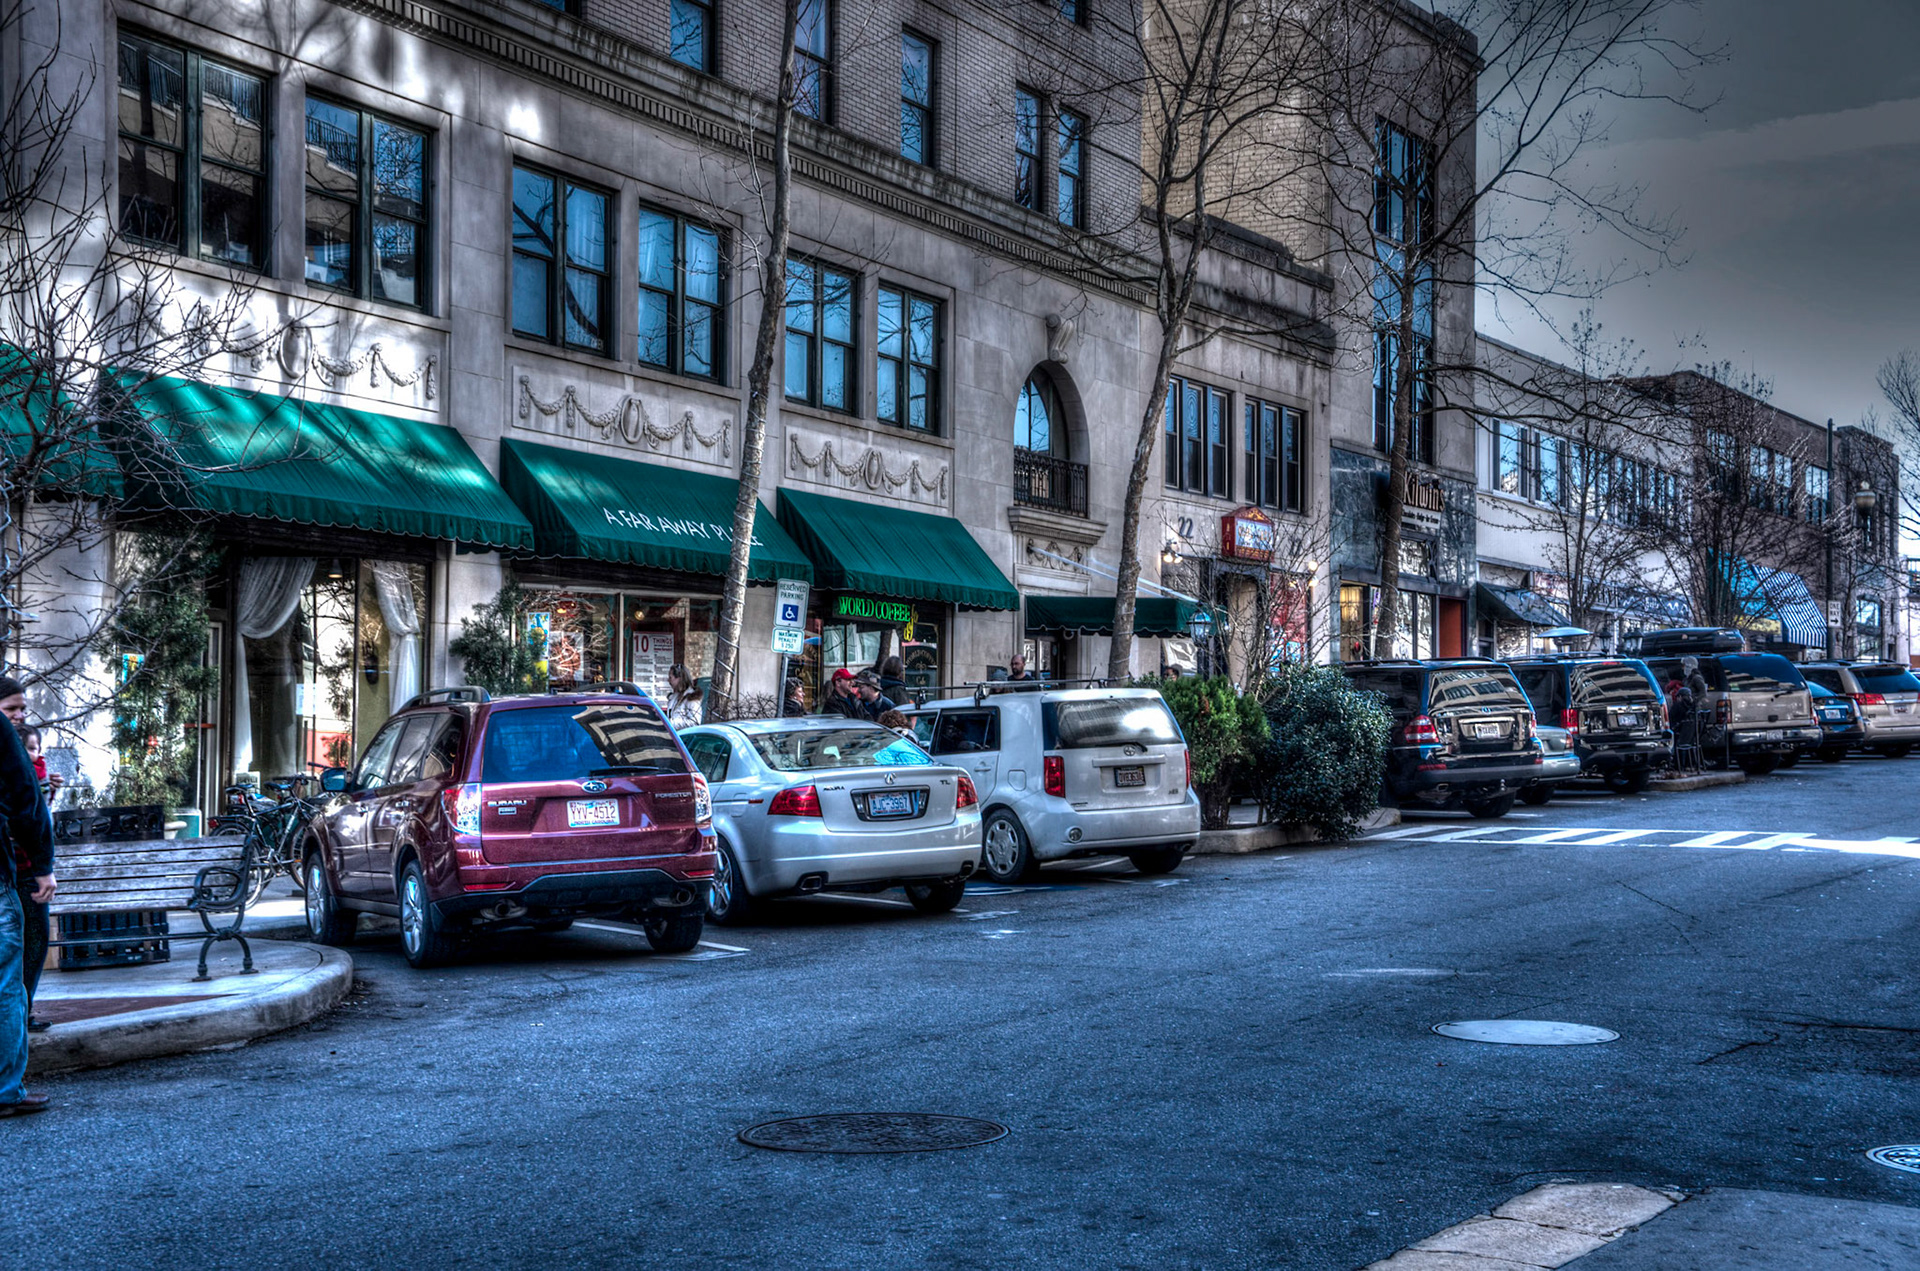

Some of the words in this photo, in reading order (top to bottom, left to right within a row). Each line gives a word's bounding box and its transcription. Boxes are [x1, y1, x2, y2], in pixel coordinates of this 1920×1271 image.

[603, 507, 624, 527] A
[617, 509, 660, 532] FAR
[656, 515, 711, 540] AWAY
[1178, 516, 1194, 539] 22
[780, 583, 807, 593] RESERVED
[780, 591, 804, 600] PARKING
[839, 596, 875, 618] WORLD
[875, 601, 911, 622] COFFEE
[1829, 602, 1840, 610] ONE
[634, 635, 649, 653] 10
[653, 637, 673, 645] THINGS
[654, 791, 692, 799] FORESTER
[487, 799, 528, 807] SUBARU
[872, 796, 908, 811] AJC-3967
[570, 804, 616, 820] YYV-4512
